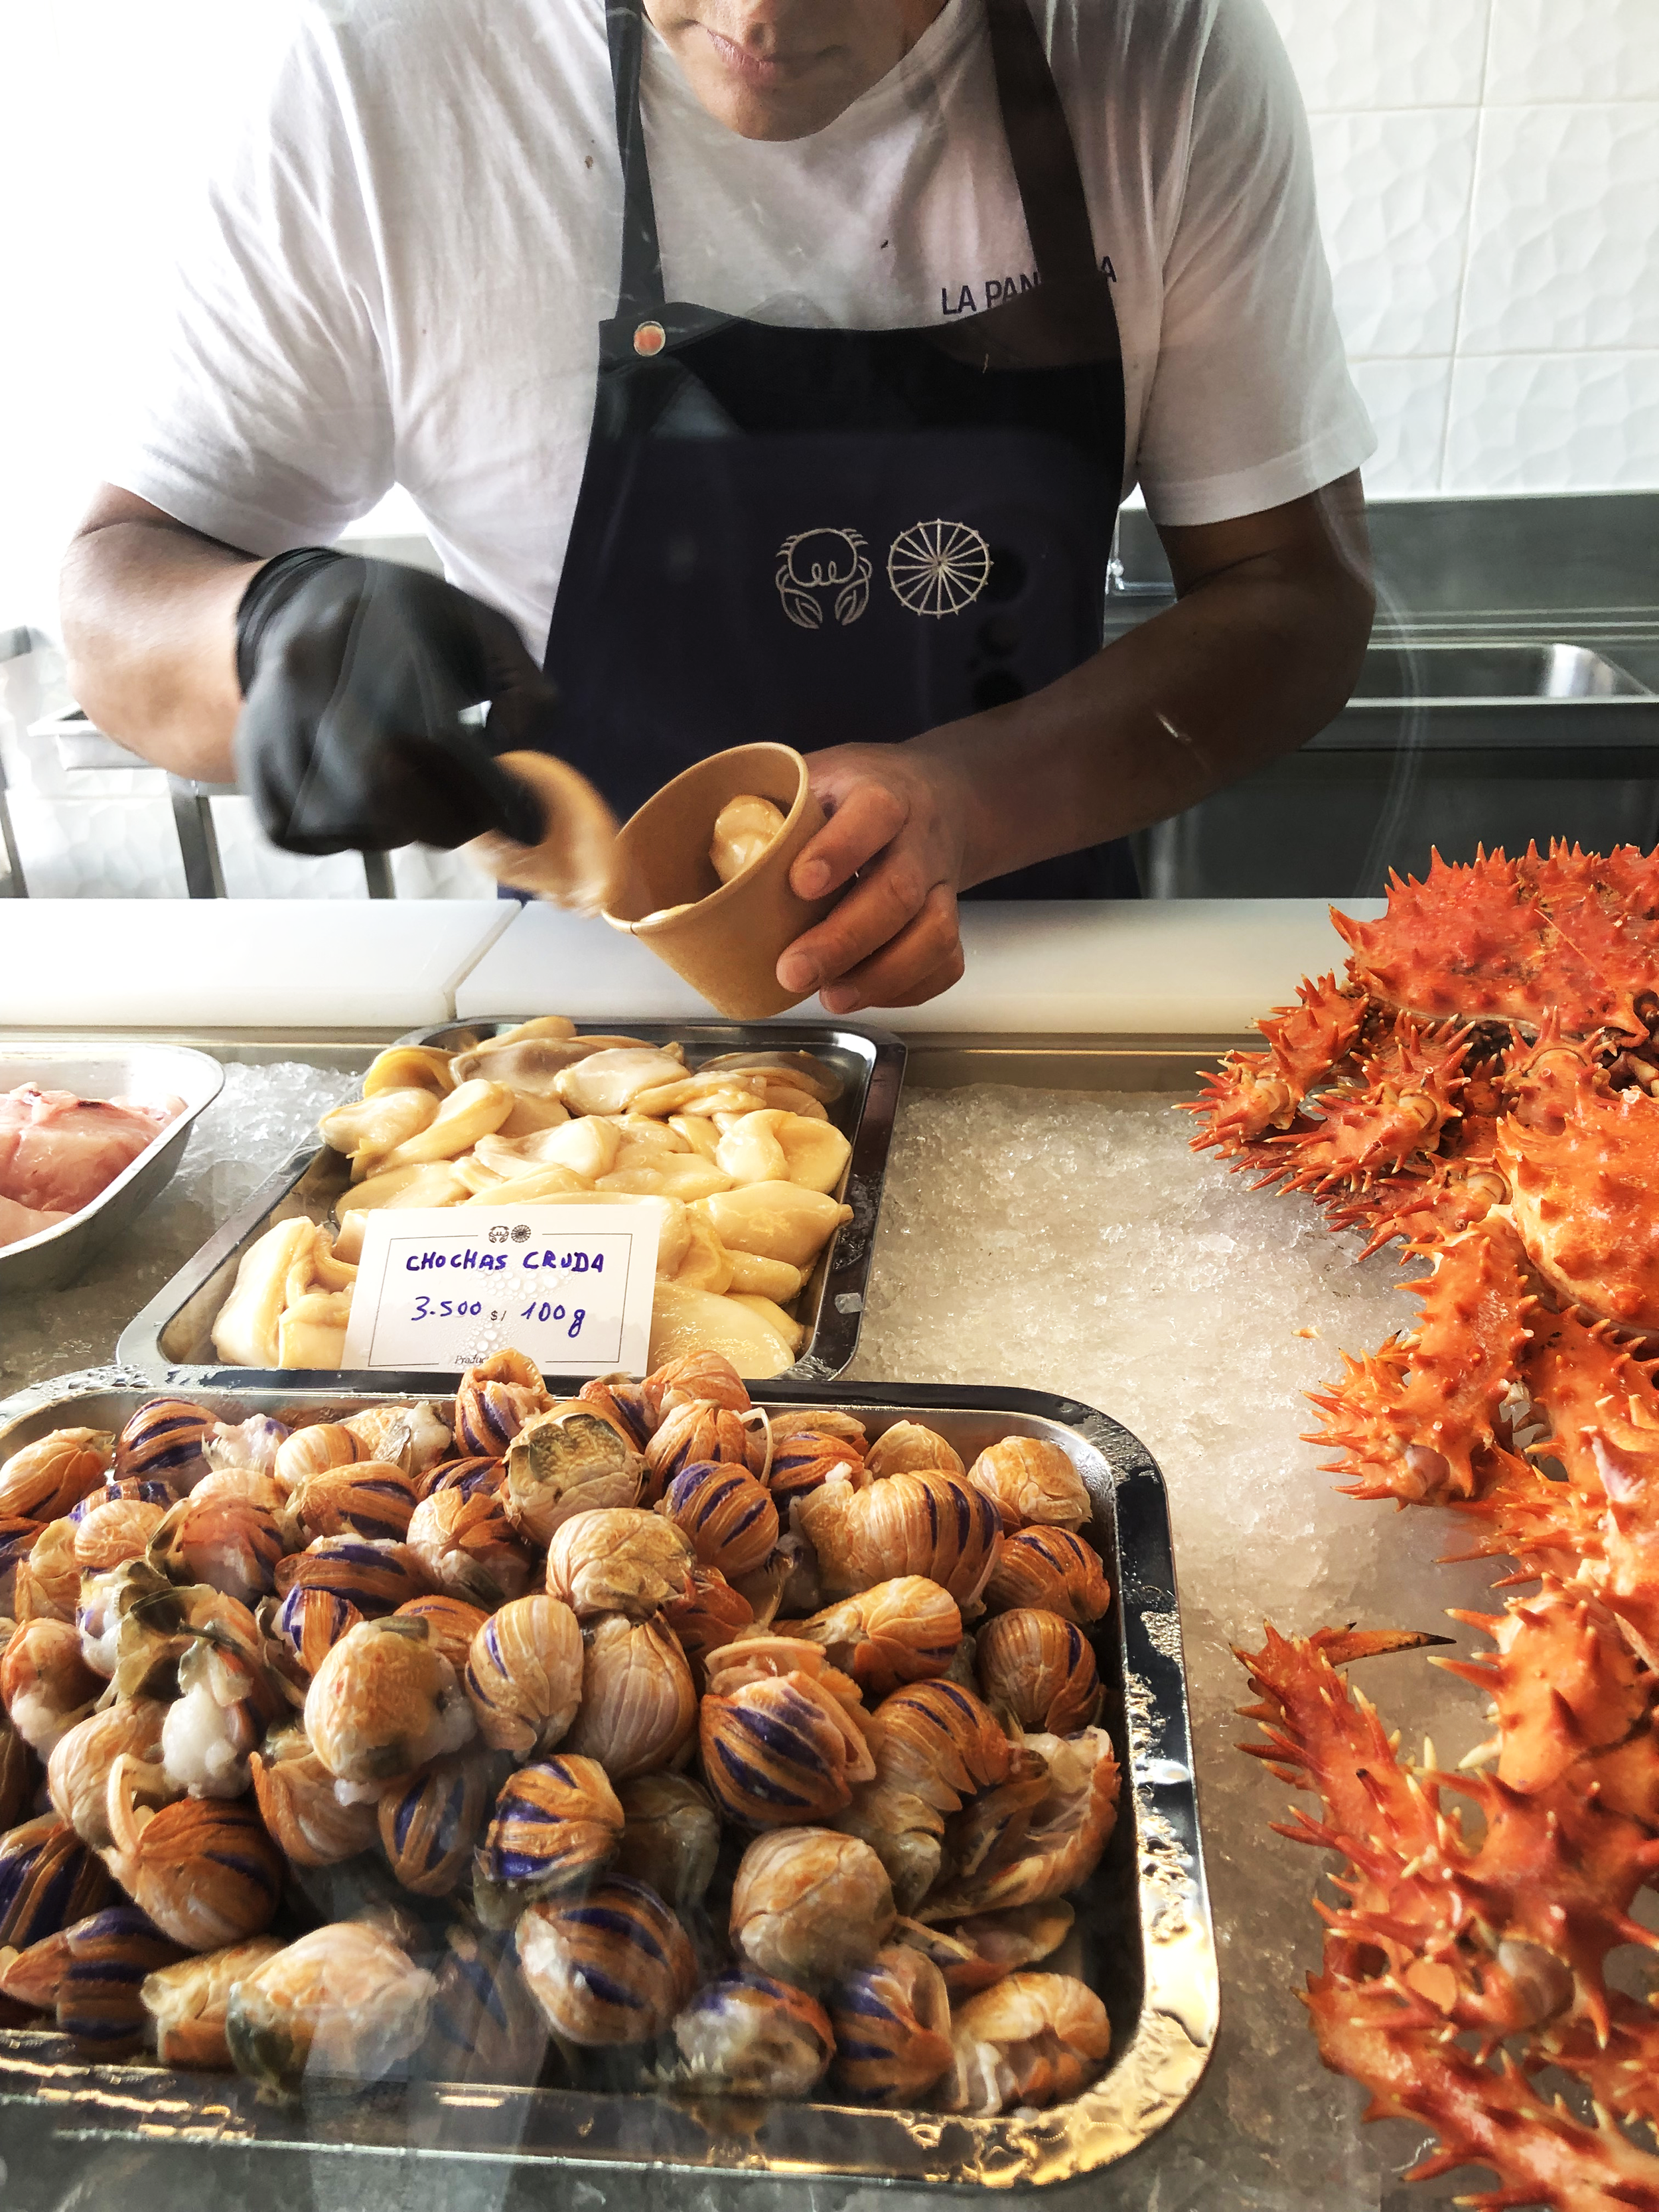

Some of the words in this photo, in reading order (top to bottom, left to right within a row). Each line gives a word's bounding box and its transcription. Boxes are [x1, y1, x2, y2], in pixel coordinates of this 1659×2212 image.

[941, 285, 977, 315] LA
[406, 1248, 508, 1272] CHOCHAS
[522, 1250, 605, 1273] CRUDA
[410, 1295, 482, 1321] 3.500
